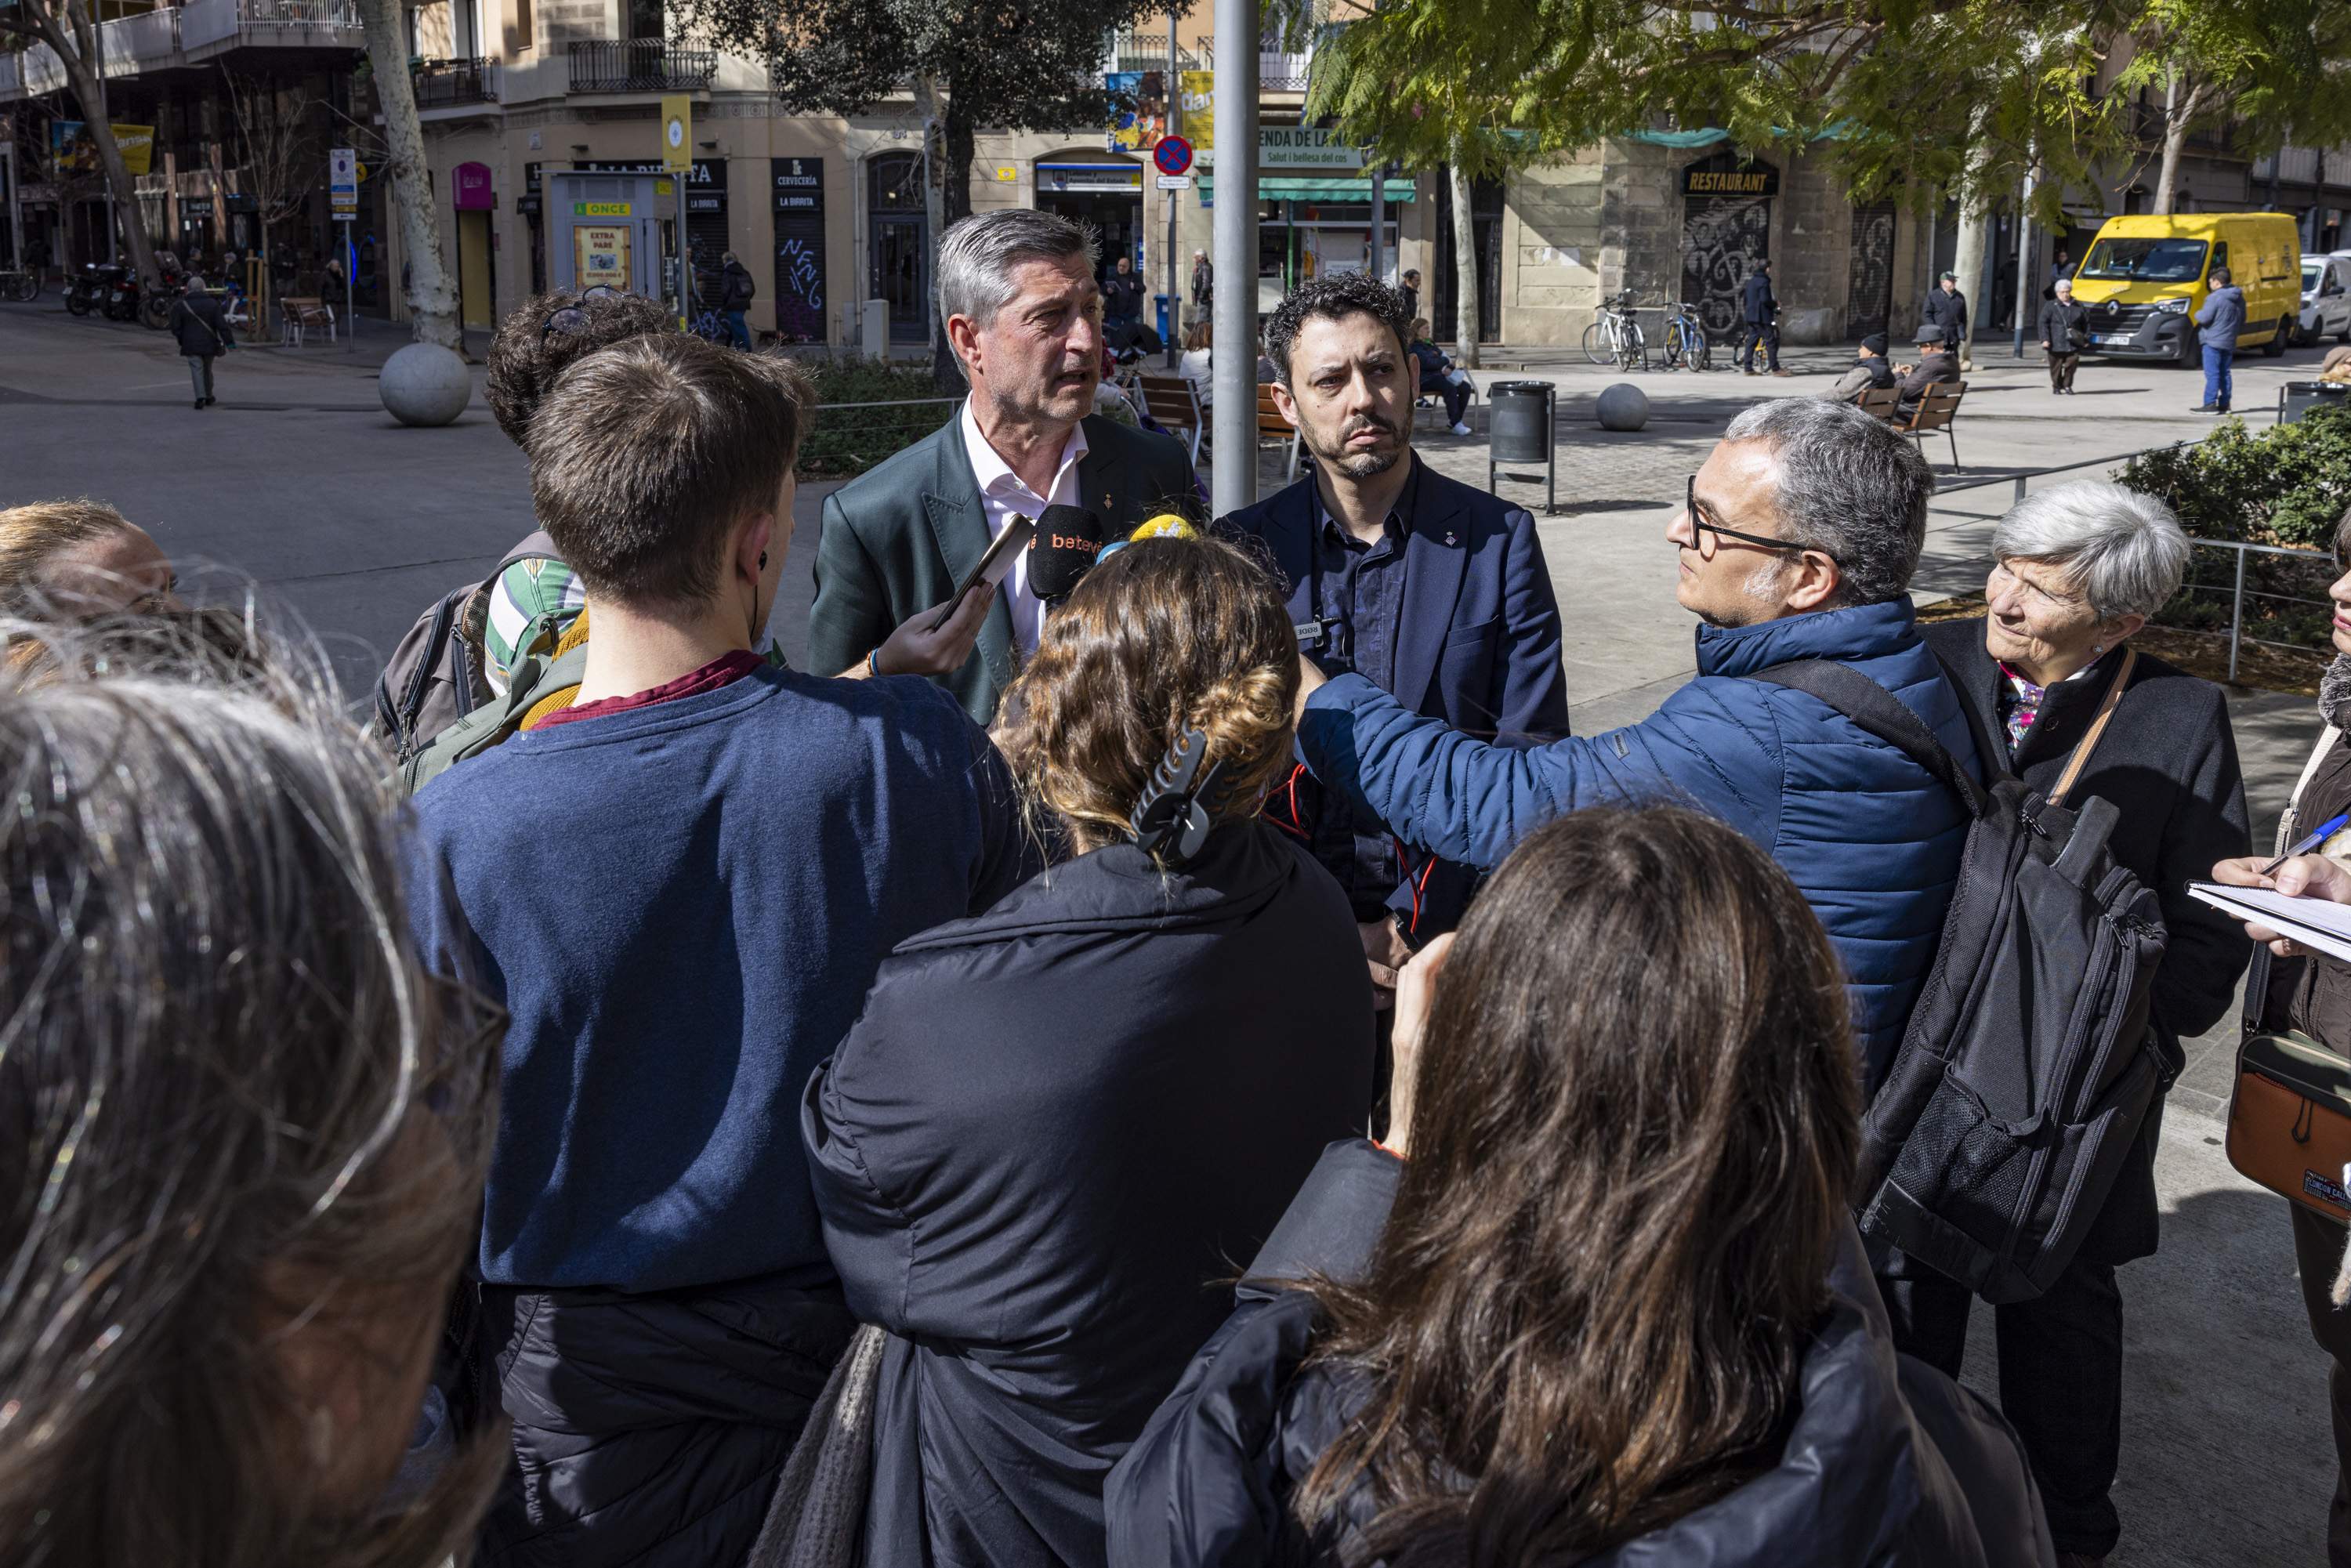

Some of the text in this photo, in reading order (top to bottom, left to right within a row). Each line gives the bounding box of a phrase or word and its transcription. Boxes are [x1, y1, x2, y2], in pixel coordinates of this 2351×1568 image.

[1295, 132, 1310, 147] DE
[1268, 152, 1287, 162] Salut
[1294, 153, 1320, 162] bellesa
[1321, 153, 1333, 162] del
[777, 174, 817, 186] CERVECERÍA
[1690, 172, 1767, 191] RESTAURANT
[780, 197, 814, 207] LA BIRRITA
[591, 205, 626, 214] ONCE
[2309, 1179, 2331, 1194] LONDON
